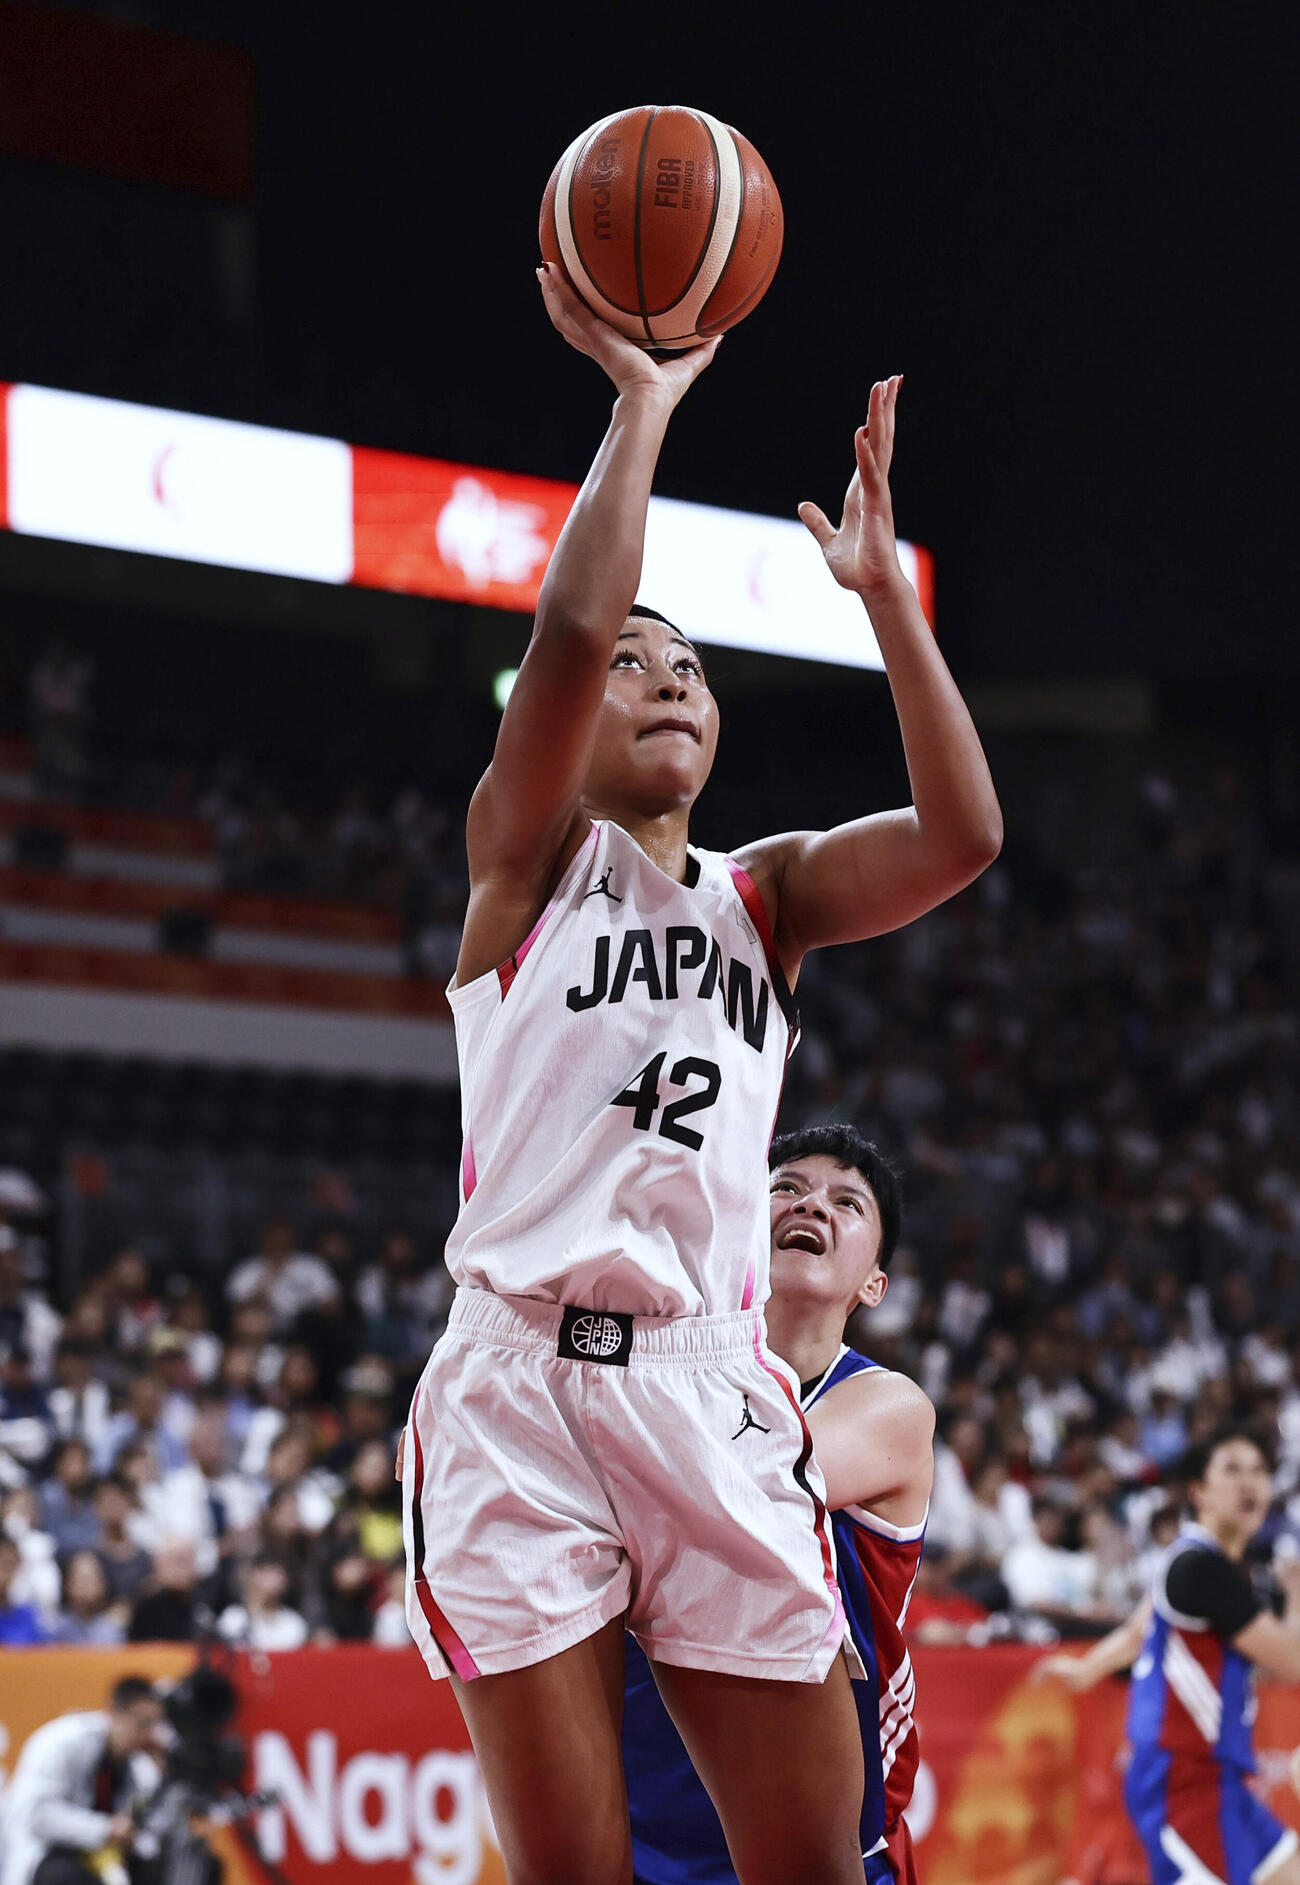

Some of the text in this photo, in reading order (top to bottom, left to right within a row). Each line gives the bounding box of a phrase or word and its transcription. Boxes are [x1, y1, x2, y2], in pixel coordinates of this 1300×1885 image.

[591, 139, 621, 240] molten
[655, 158, 681, 208] FIBA
[682, 161, 695, 209] APPROVED
[566, 926, 769, 1053] JAPAN
[608, 1051, 722, 1152] 42
[589, 1317, 602, 1356] JPN
[253, 1728, 502, 1885] Nag
